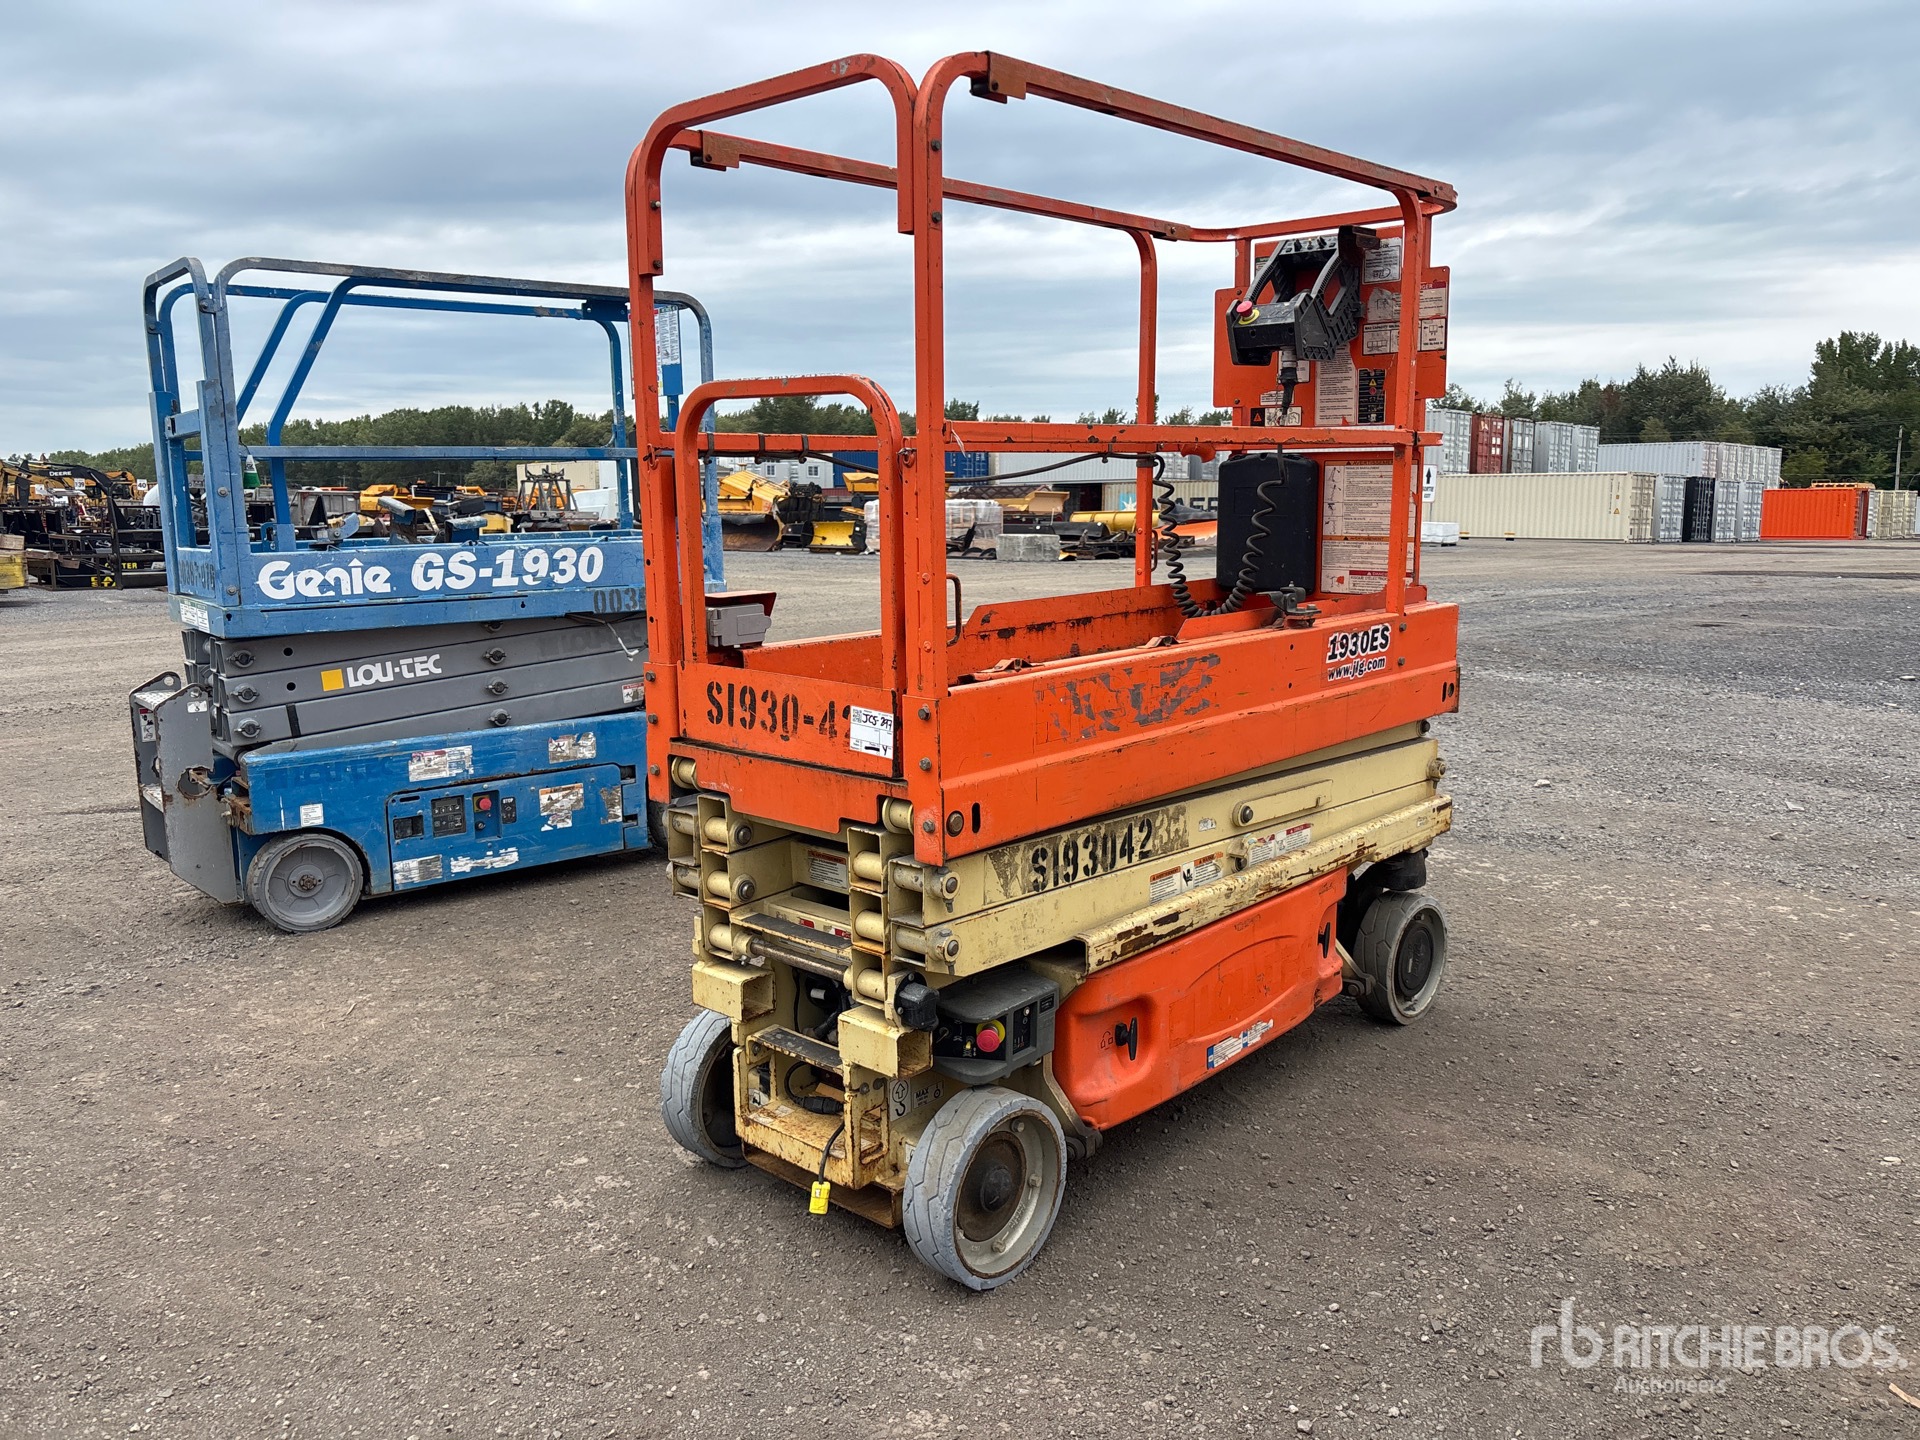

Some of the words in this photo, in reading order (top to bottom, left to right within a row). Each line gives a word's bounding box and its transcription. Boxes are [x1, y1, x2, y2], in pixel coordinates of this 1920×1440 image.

[258, 558, 391, 600] Genie
[411, 547, 604, 591] GS-1930
[1327, 624, 1390, 661] 1930ES
[1328, 657, 1385, 680] www.jlg.com
